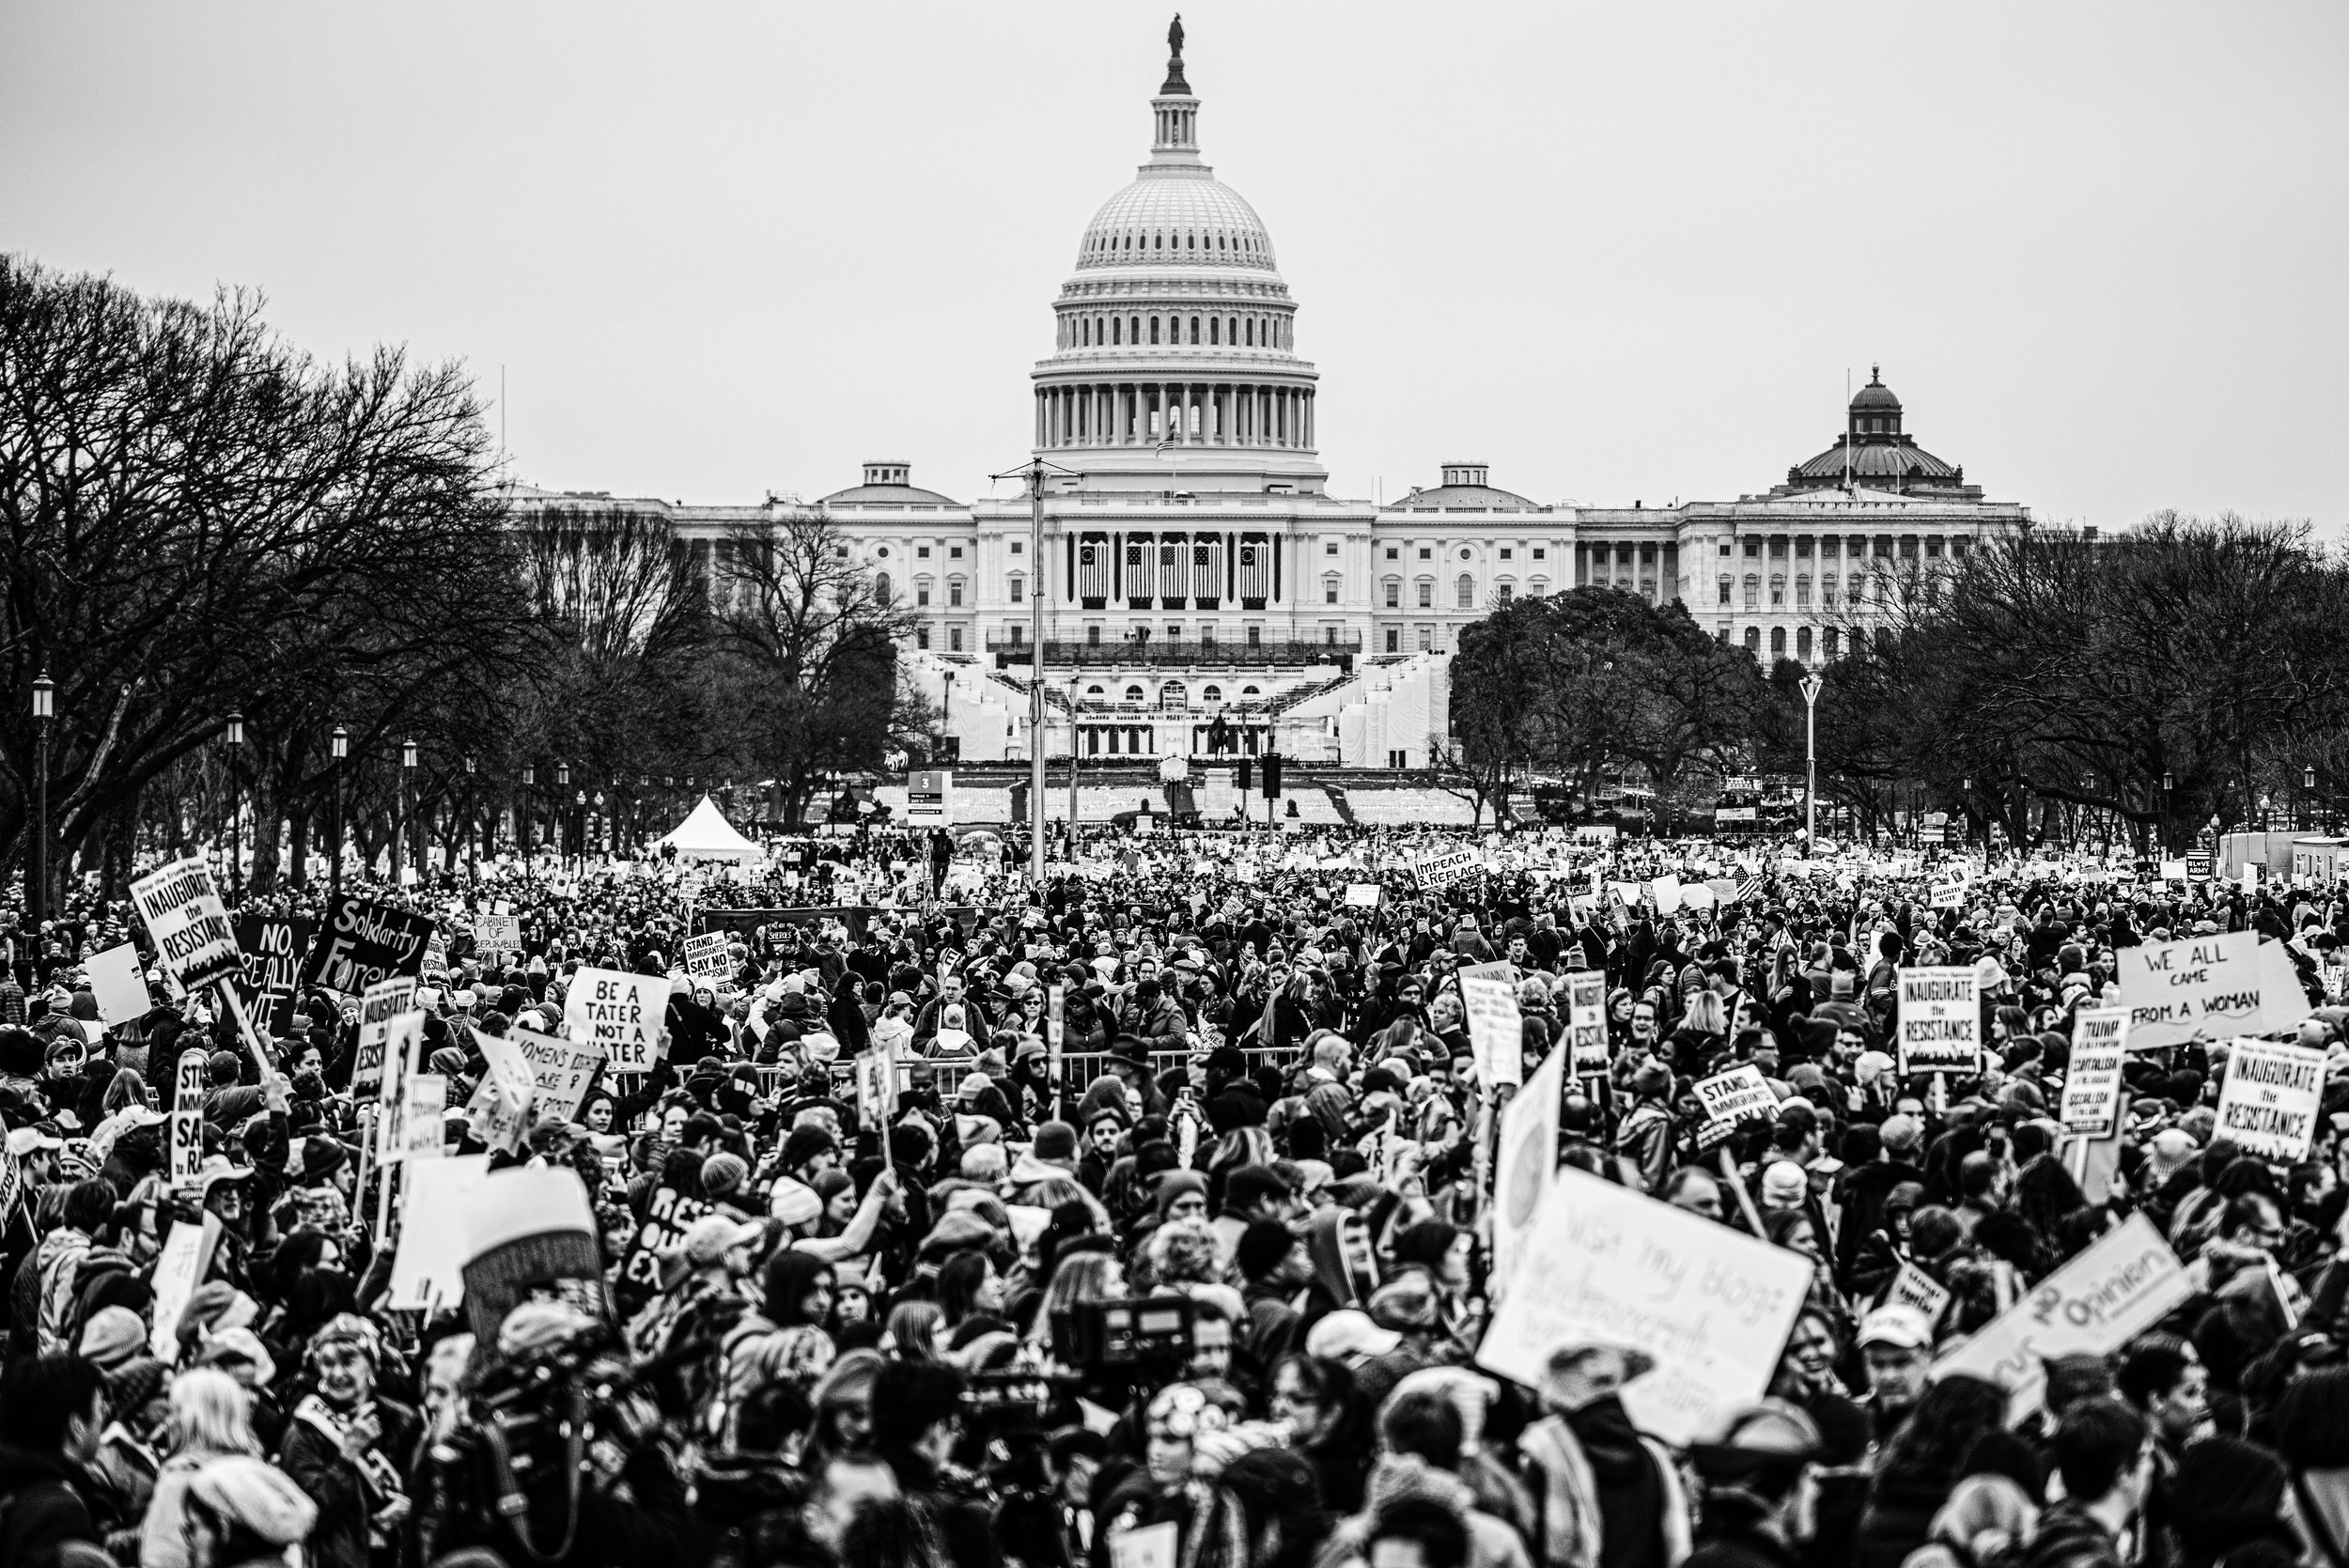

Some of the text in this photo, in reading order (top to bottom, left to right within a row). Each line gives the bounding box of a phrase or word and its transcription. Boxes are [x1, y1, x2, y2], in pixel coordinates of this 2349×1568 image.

[922, 778, 929, 789] 3
[1415, 852, 1471, 877] IMPEACH
[1417, 863, 1484, 887] & REPLACE
[1938, 894, 1956, 904] MATE
[185, 904, 203, 921] the
[475, 916, 516, 928] CABINET
[259, 924, 294, 959] NO,
[334, 900, 421, 964] Solidarity
[489, 927, 504, 938] OF
[686, 936, 713, 952] STAND
[688, 944, 725, 960] IMMIGRANTS!
[690, 954, 727, 973] SAY NO
[2144, 943, 2229, 971] WE ALL
[232, 952, 304, 993] REALLY
[2170, 969, 2209, 986] CAME
[596, 981, 640, 1003] BE A
[1905, 981, 1973, 1002] INAUGURATE
[585, 1001, 642, 1024] TATER
[1931, 1005, 1946, 1016] the
[2131, 990, 2261, 1025] FROM A WOMAN
[595, 1024, 646, 1043] NOT A
[1906, 1020, 1973, 1042] RESISTANCE
[586, 1041, 646, 1063] ATER
[180, 1063, 203, 1089] ST
[536, 1072, 562, 1088] ARE
[2233, 1055, 2317, 1092] INAUGURATE
[1703, 1077, 1750, 1101] STAND
[2262, 1090, 2277, 1103] the
[2223, 1101, 2308, 1139] RESISTANCE
[1637, 1240, 1688, 1304] my
[1697, 1256, 1785, 1327] blog:
